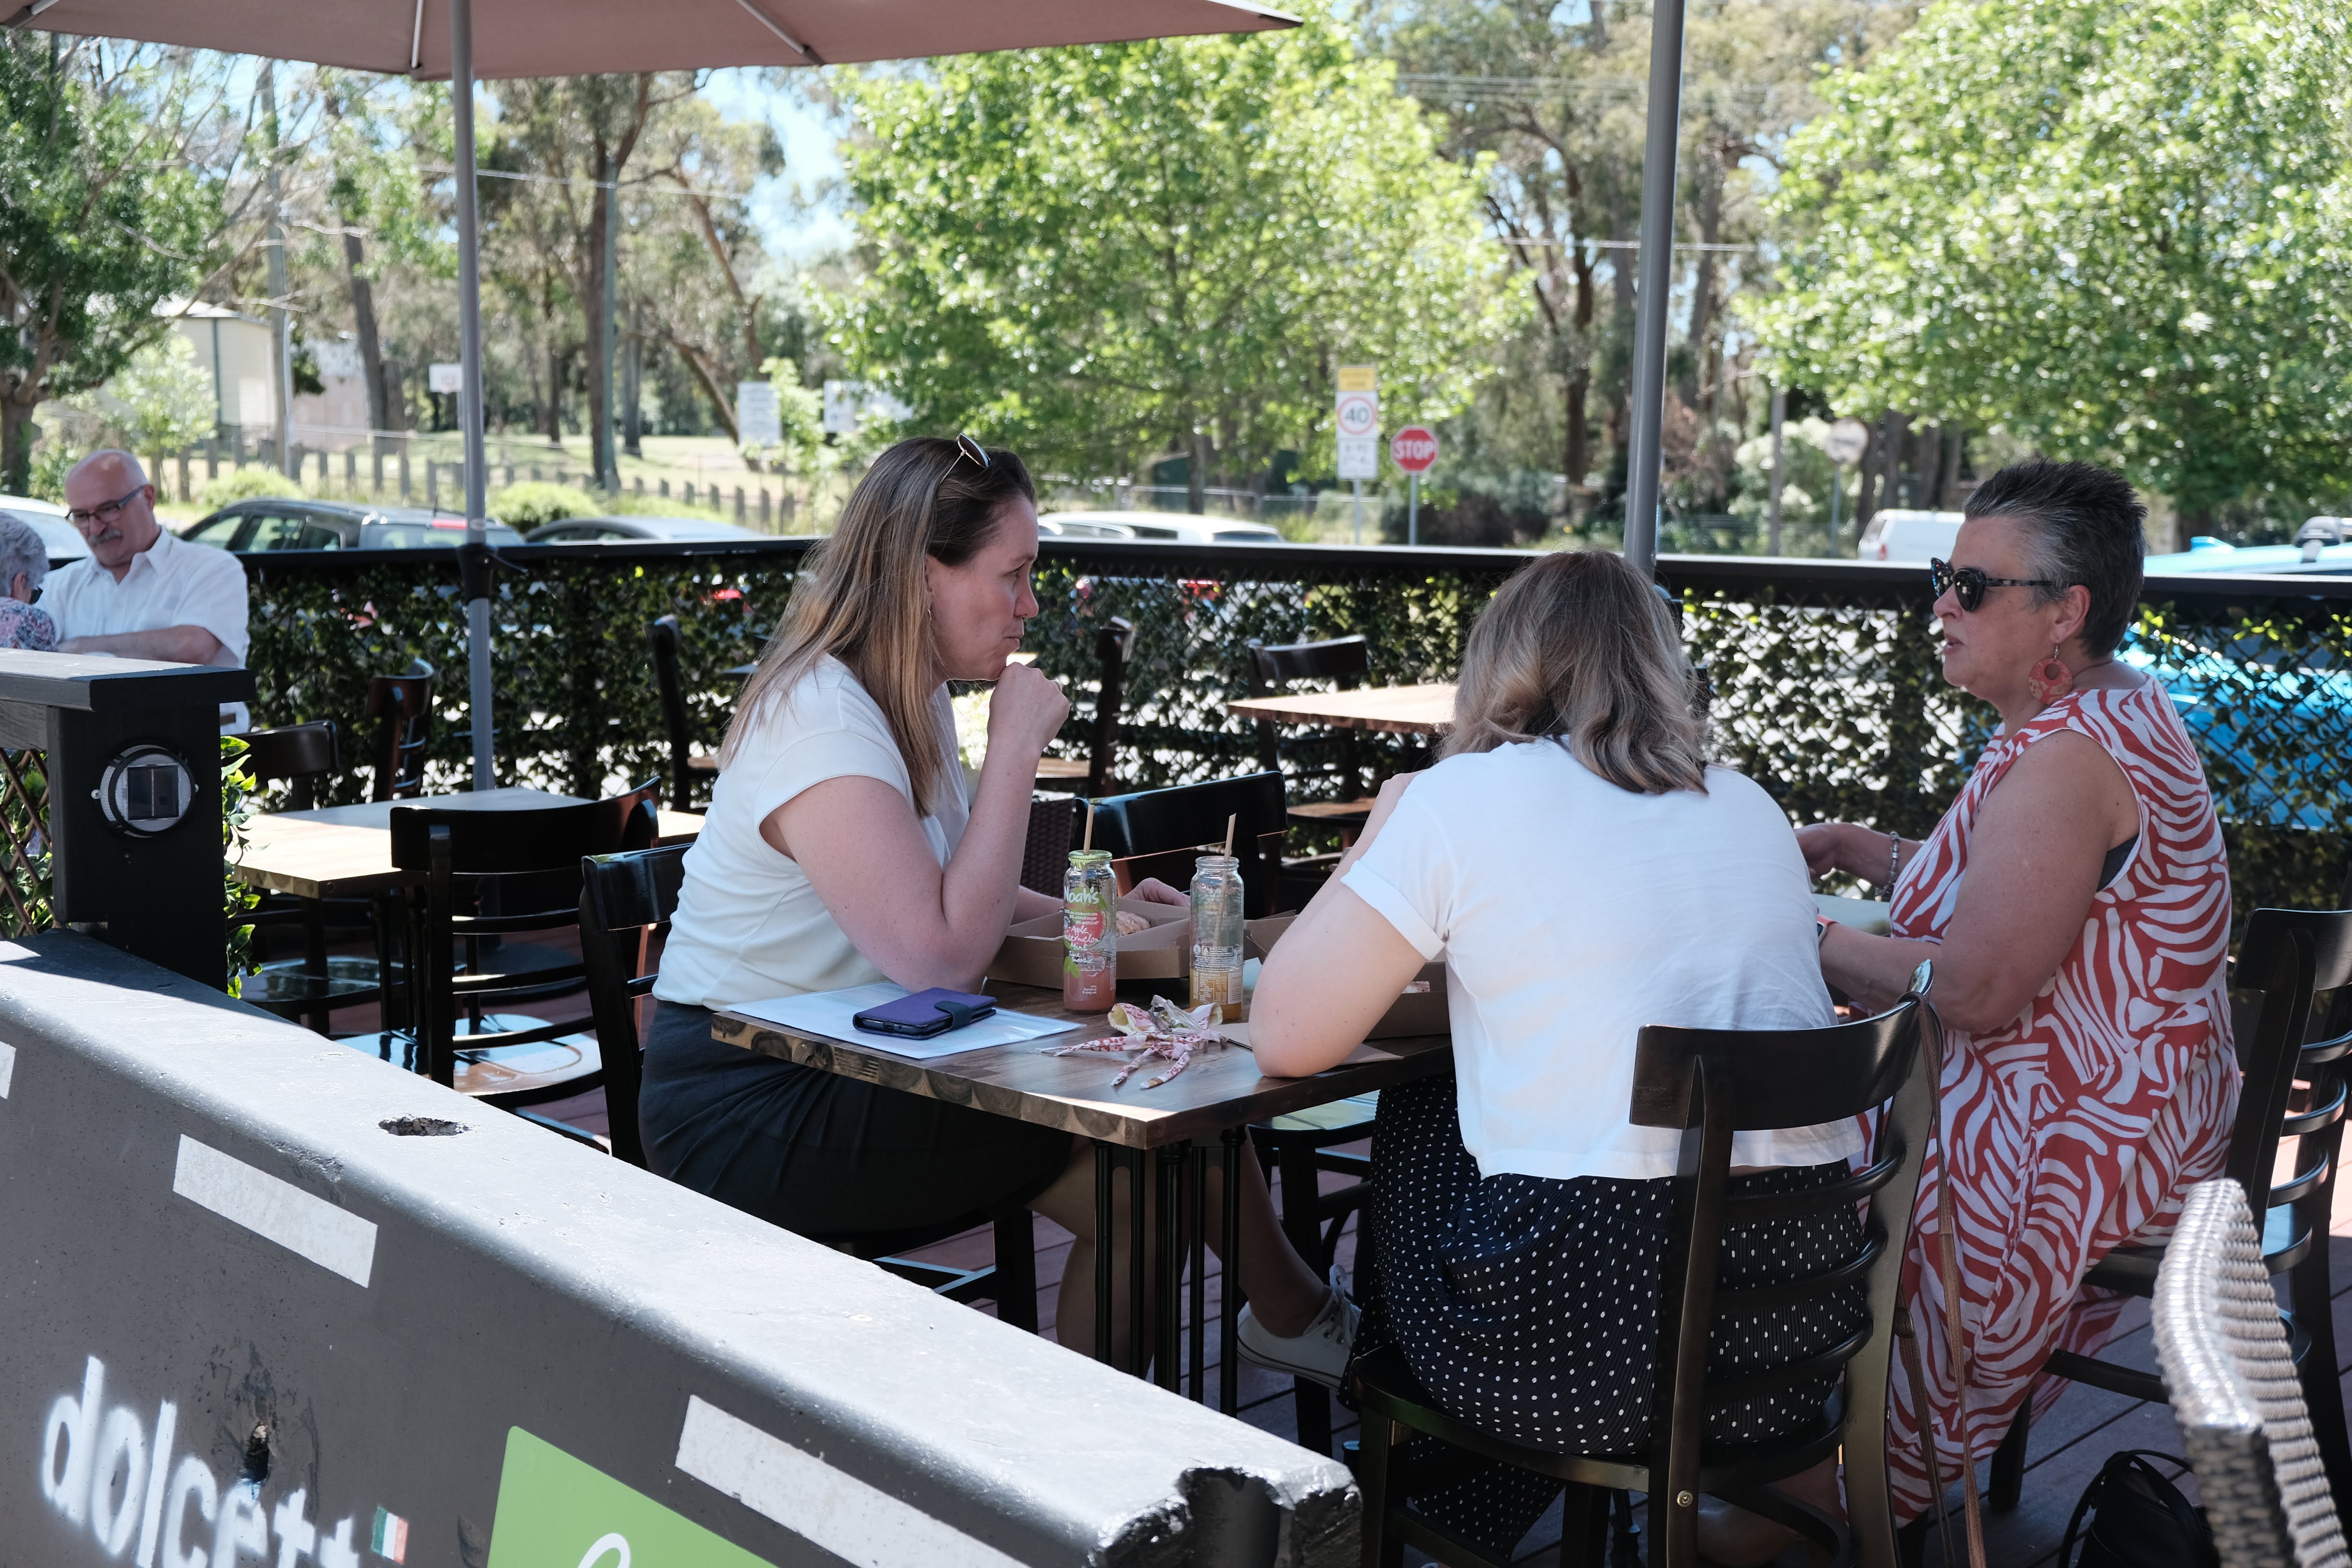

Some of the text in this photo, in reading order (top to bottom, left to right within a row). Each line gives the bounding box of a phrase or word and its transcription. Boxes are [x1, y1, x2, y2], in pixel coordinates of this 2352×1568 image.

[1345, 407, 1369, 423] 40
[1394, 439, 1434, 461] STOP
[1064, 886, 1100, 904] Noah's
[1071, 925, 1089, 936] Apple
[1070, 942, 1088, 951] Mint
